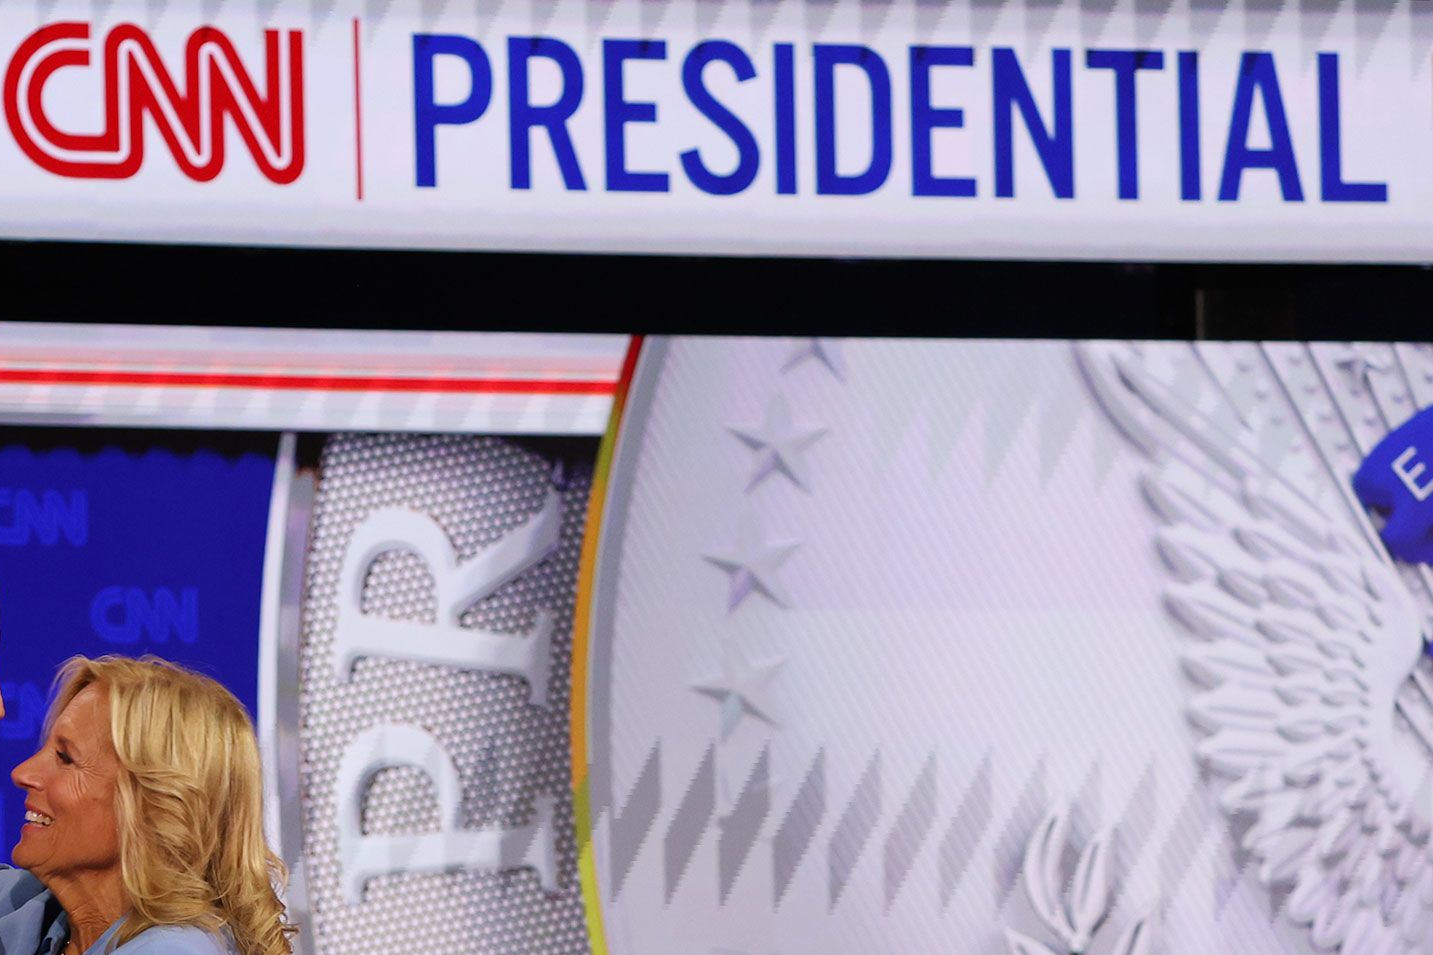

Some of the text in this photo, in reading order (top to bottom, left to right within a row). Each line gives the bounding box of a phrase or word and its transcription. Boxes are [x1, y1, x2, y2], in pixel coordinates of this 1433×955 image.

[2, 21, 1388, 203] CNN PRESIDENTIAL
[89, 584, 199, 646] CNN
